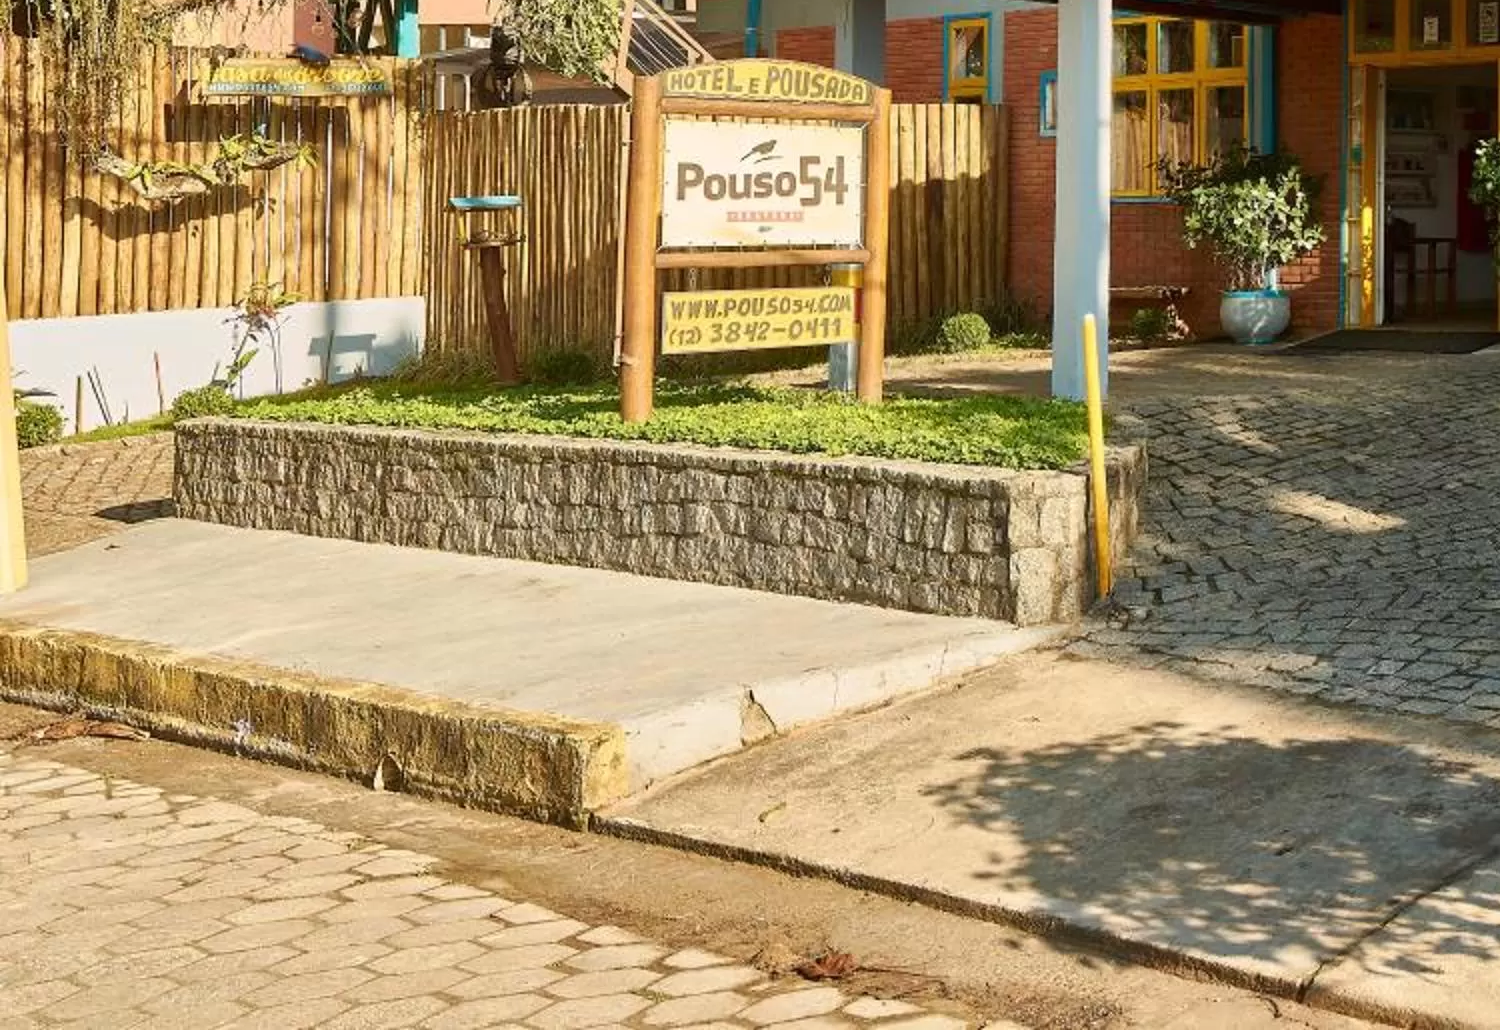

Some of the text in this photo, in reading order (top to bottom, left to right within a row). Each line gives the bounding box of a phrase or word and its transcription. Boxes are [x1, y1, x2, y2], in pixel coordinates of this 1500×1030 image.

[670, 66, 864, 101] HOTEL E POUSADA
[668, 326, 701, 346] (12)
